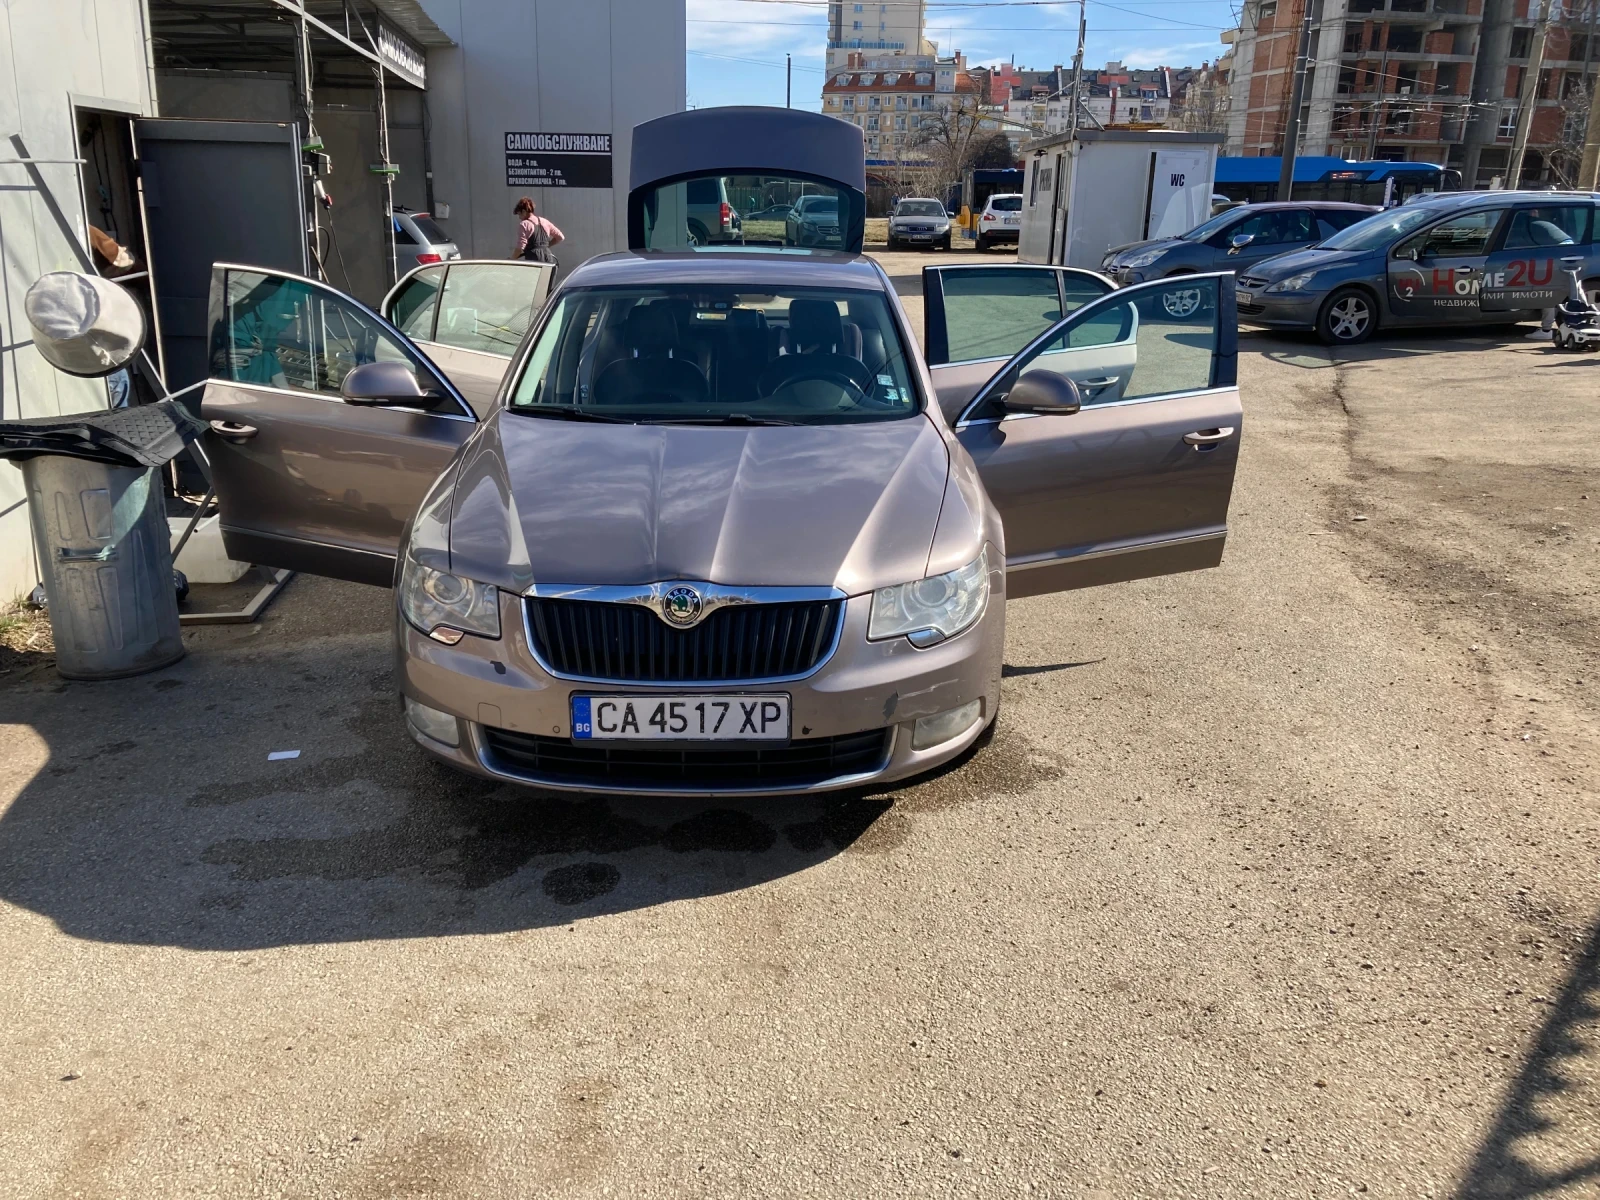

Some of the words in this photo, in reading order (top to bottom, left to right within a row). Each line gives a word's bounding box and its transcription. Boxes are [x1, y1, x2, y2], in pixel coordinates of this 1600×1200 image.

[507, 134, 610, 151] САМООБСЛУЖВАНЕ
[507, 159, 522, 167] ВОДА
[508, 168, 546, 176] БЕЗКОНТАКТНО
[1171, 173, 1185, 187] WC
[1405, 286, 1413, 297] 2
[597, 702, 640, 733] CA
[648, 702, 730, 733] 4517
[739, 702, 781, 733] XP
[576, 723, 590, 732] BG
